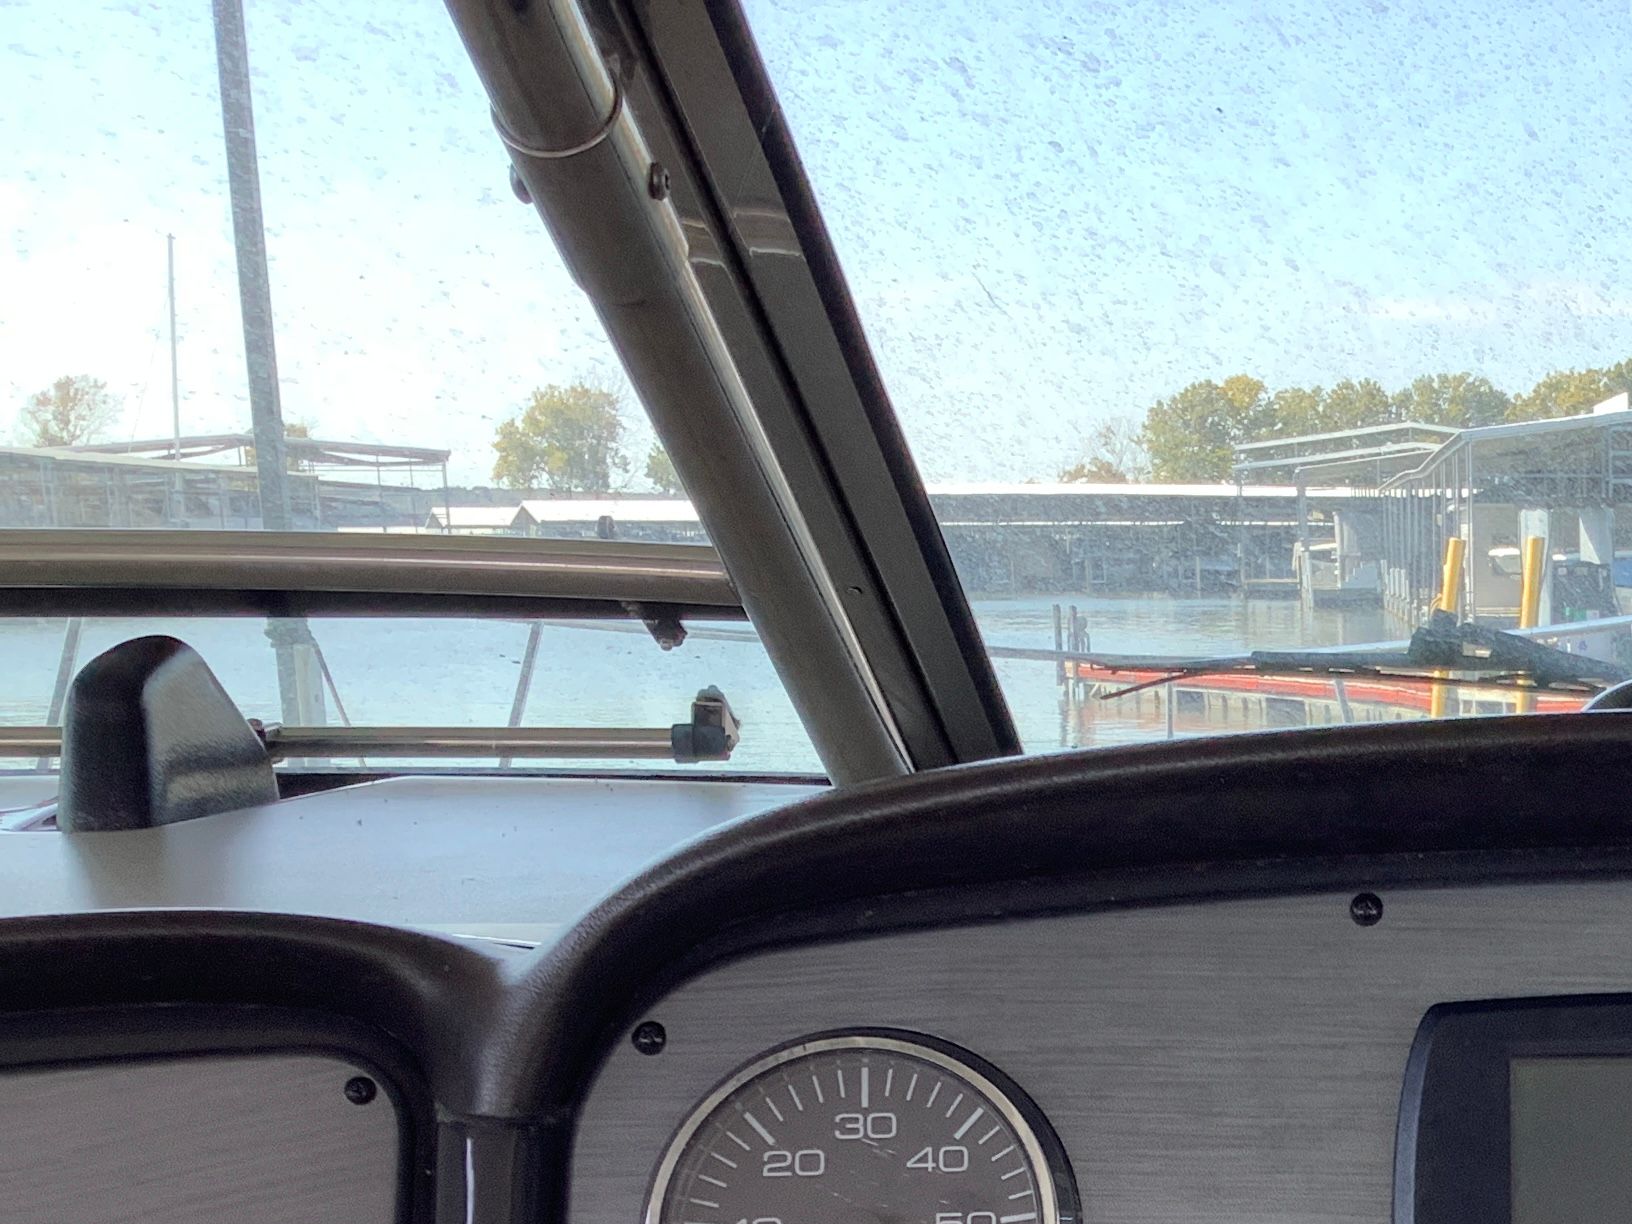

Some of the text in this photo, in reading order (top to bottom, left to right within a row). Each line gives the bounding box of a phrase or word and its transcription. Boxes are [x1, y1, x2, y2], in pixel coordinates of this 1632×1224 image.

[834, 1112, 897, 1140] 30
[762, 1149, 826, 1177] 20
[906, 1145, 970, 1172] 40
